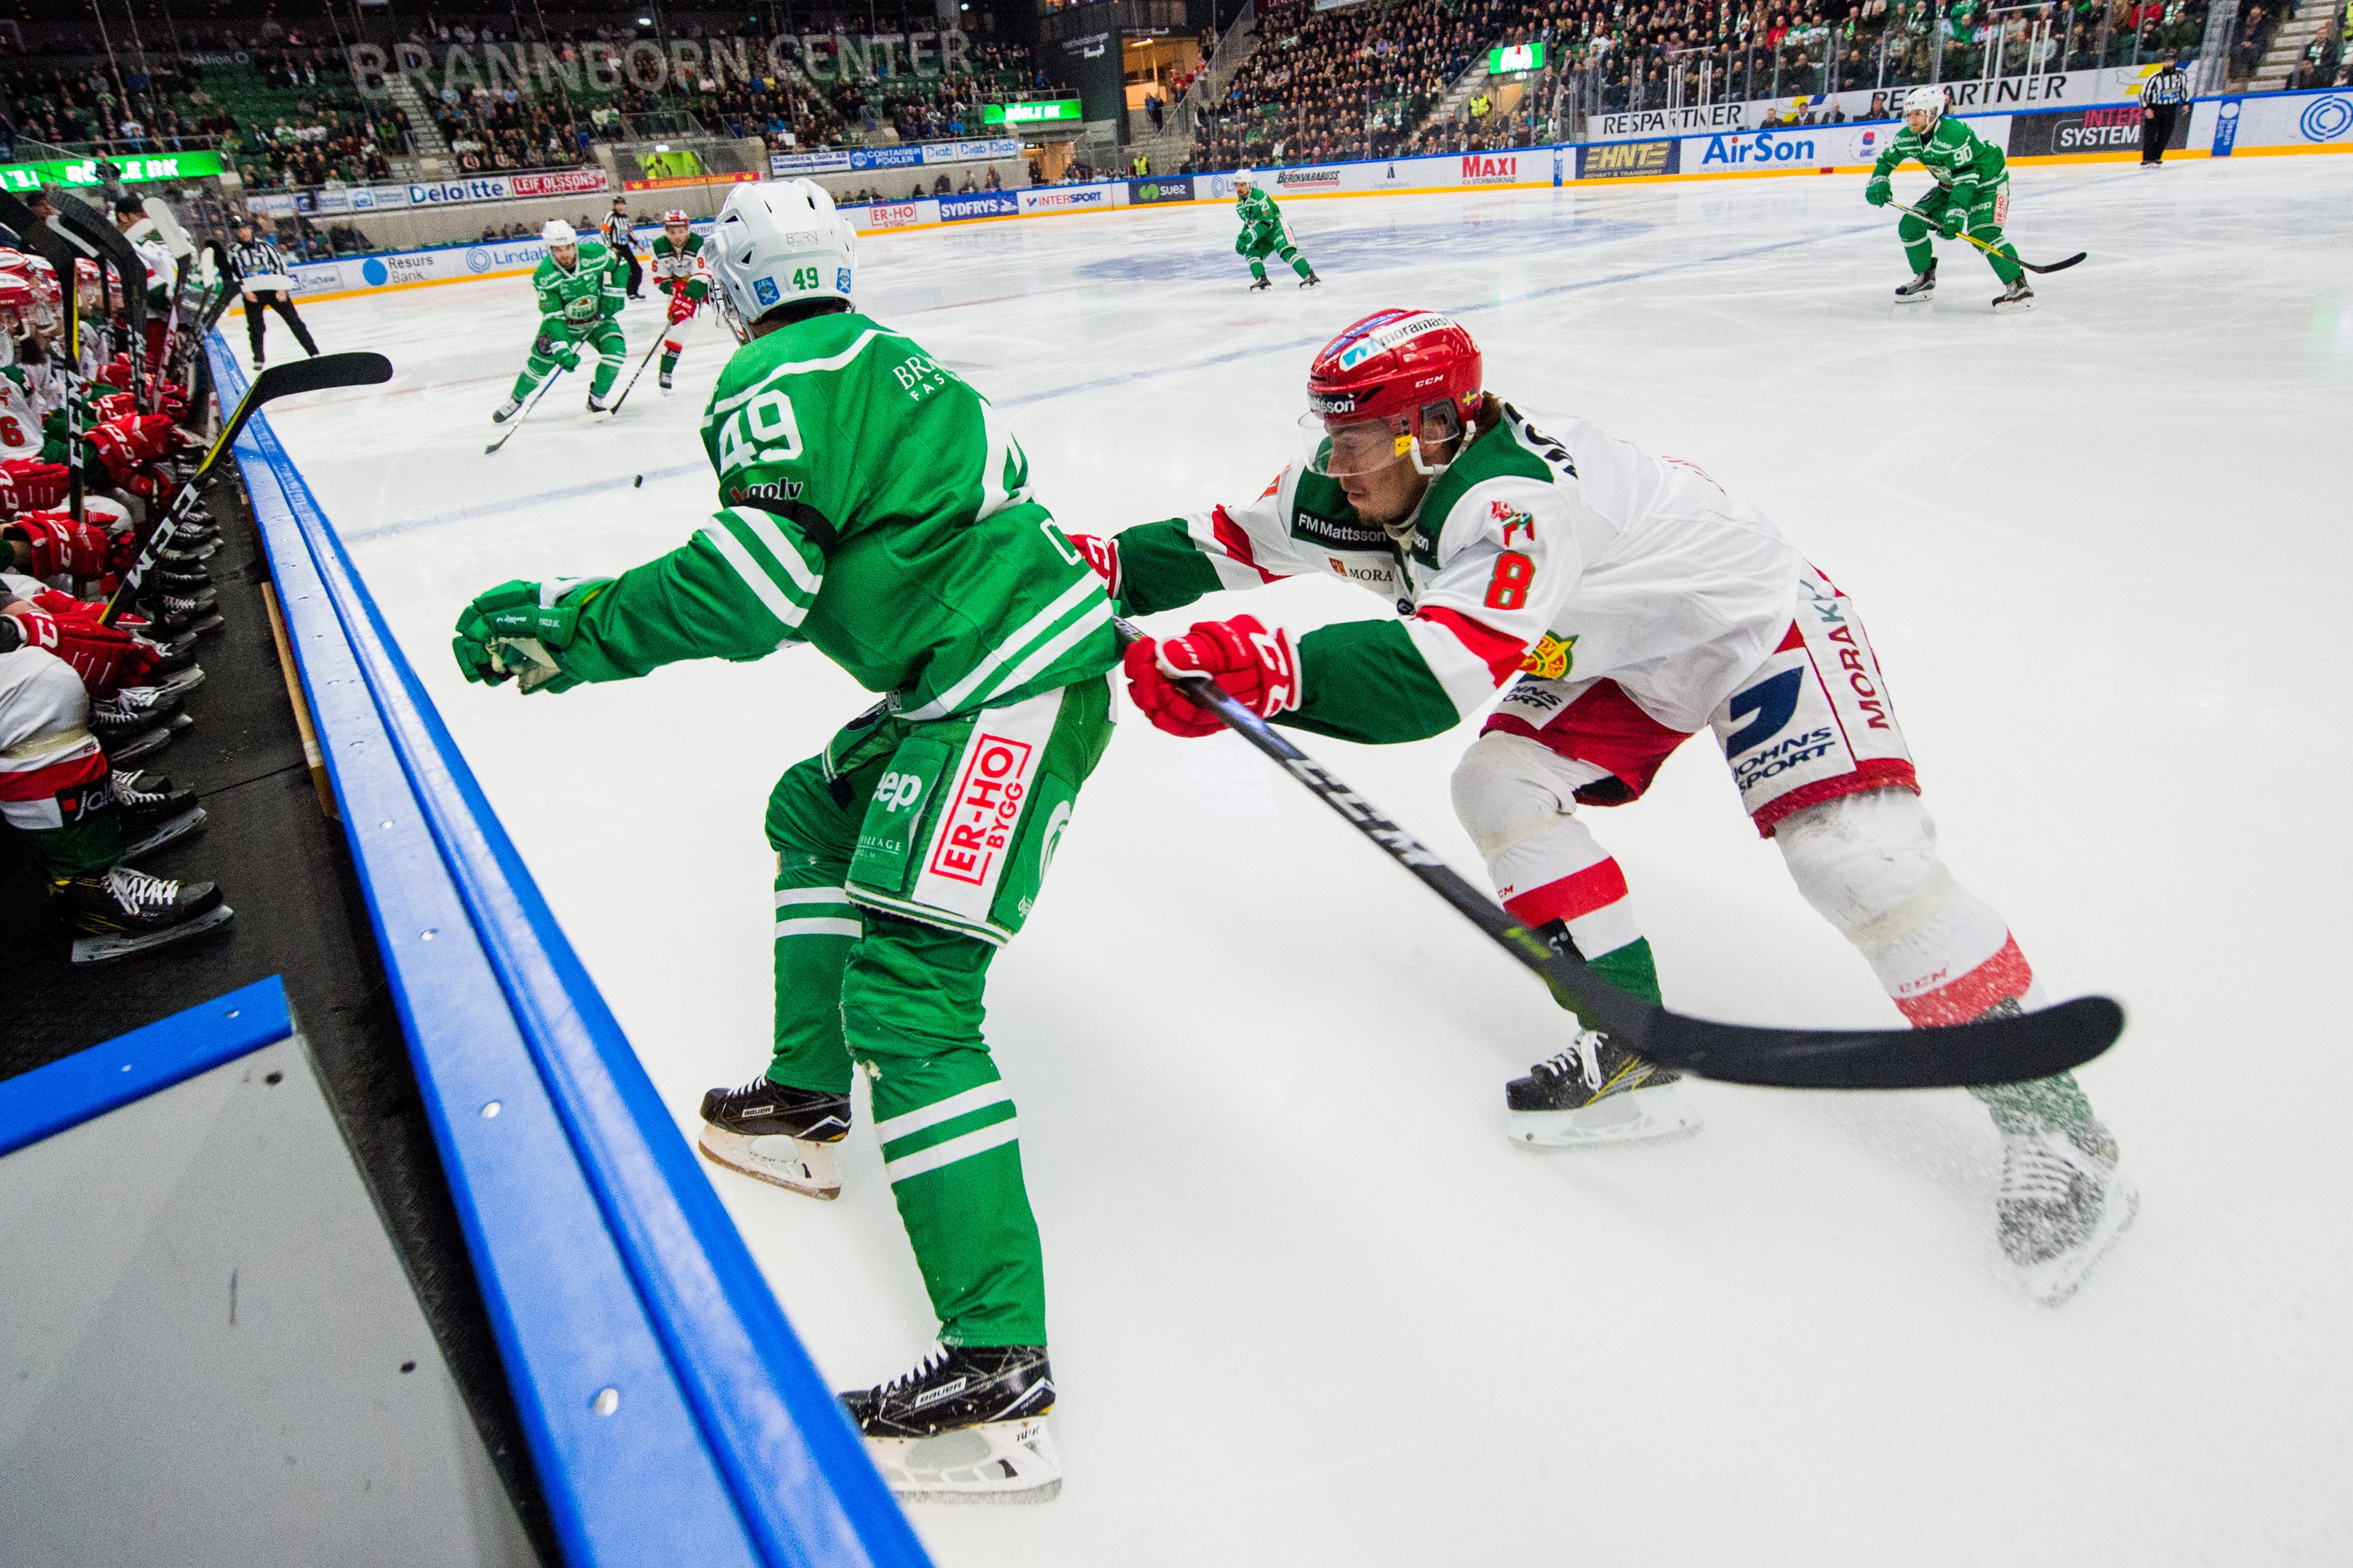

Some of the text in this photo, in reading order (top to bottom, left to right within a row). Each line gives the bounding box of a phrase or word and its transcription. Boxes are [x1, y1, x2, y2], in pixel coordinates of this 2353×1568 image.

[2084, 107, 2142, 127] INTER
[2060, 124, 2141, 147] SYSTEM
[867, 147, 921, 159] CONTAINER
[960, 143, 987, 154] Diab
[990, 141, 1015, 154] Diab
[1702, 132, 1815, 165] AirSon
[1954, 147, 1973, 166] 90
[1463, 155, 1516, 178] MAXI
[515, 173, 597, 192] LEIF OLSSONS
[1160, 183, 1186, 195] suez
[1472, 176, 1516, 185] STORMARKNAD
[1038, 191, 1101, 206] INTERSPORT
[873, 205, 914, 221] ER-HO
[941, 198, 998, 220] SYDFRYS
[884, 218, 905, 227] BYGG
[389, 254, 433, 269] Resurs
[392, 267, 424, 283] Bank
[793, 267, 819, 290] 49
[1416, 375, 1444, 388] CCM
[719, 389, 804, 476] 49
[1299, 513, 1387, 543] FM Mattsson
[1349, 566, 1393, 583] MORA
[1485, 550, 1536, 610] 8
[942, 746, 1014, 872] ER-HO
[986, 782, 1023, 850] BYGG
[1899, 967, 1948, 993] CCM
[744, 1106, 772, 1118] BAUER
[919, 1380, 963, 1405] BAUER
